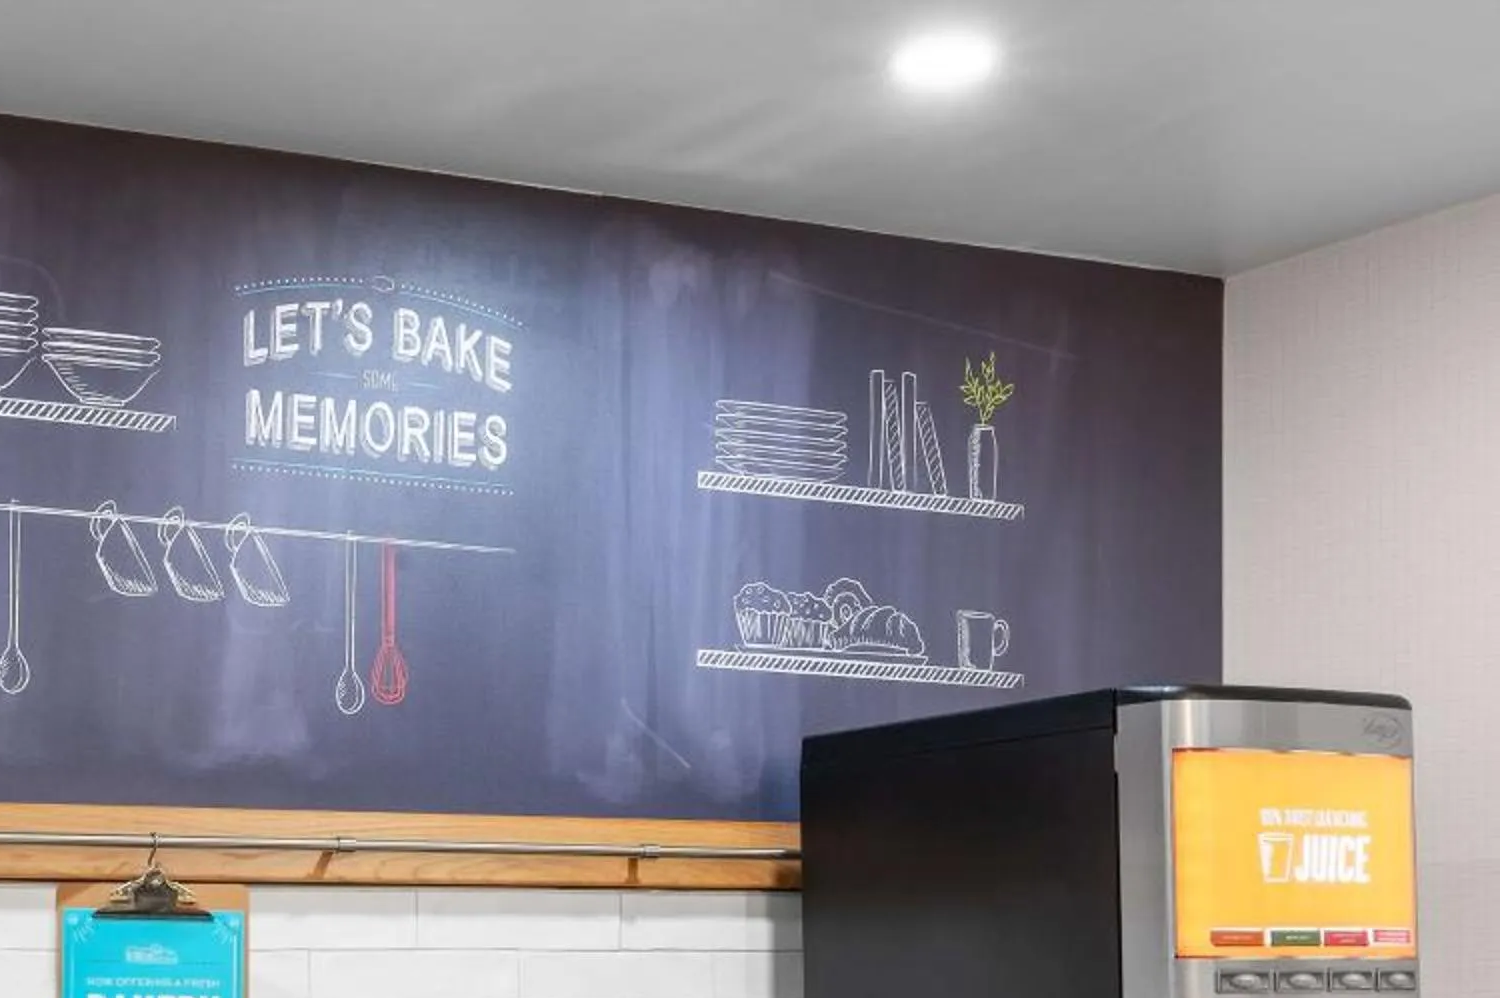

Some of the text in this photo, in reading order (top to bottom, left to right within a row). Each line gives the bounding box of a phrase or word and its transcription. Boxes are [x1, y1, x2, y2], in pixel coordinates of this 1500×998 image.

[243, 298, 512, 392] LET'S BAKE
[245, 388, 507, 471] MEMORIES
[1295, 834, 1372, 883] JUICE
